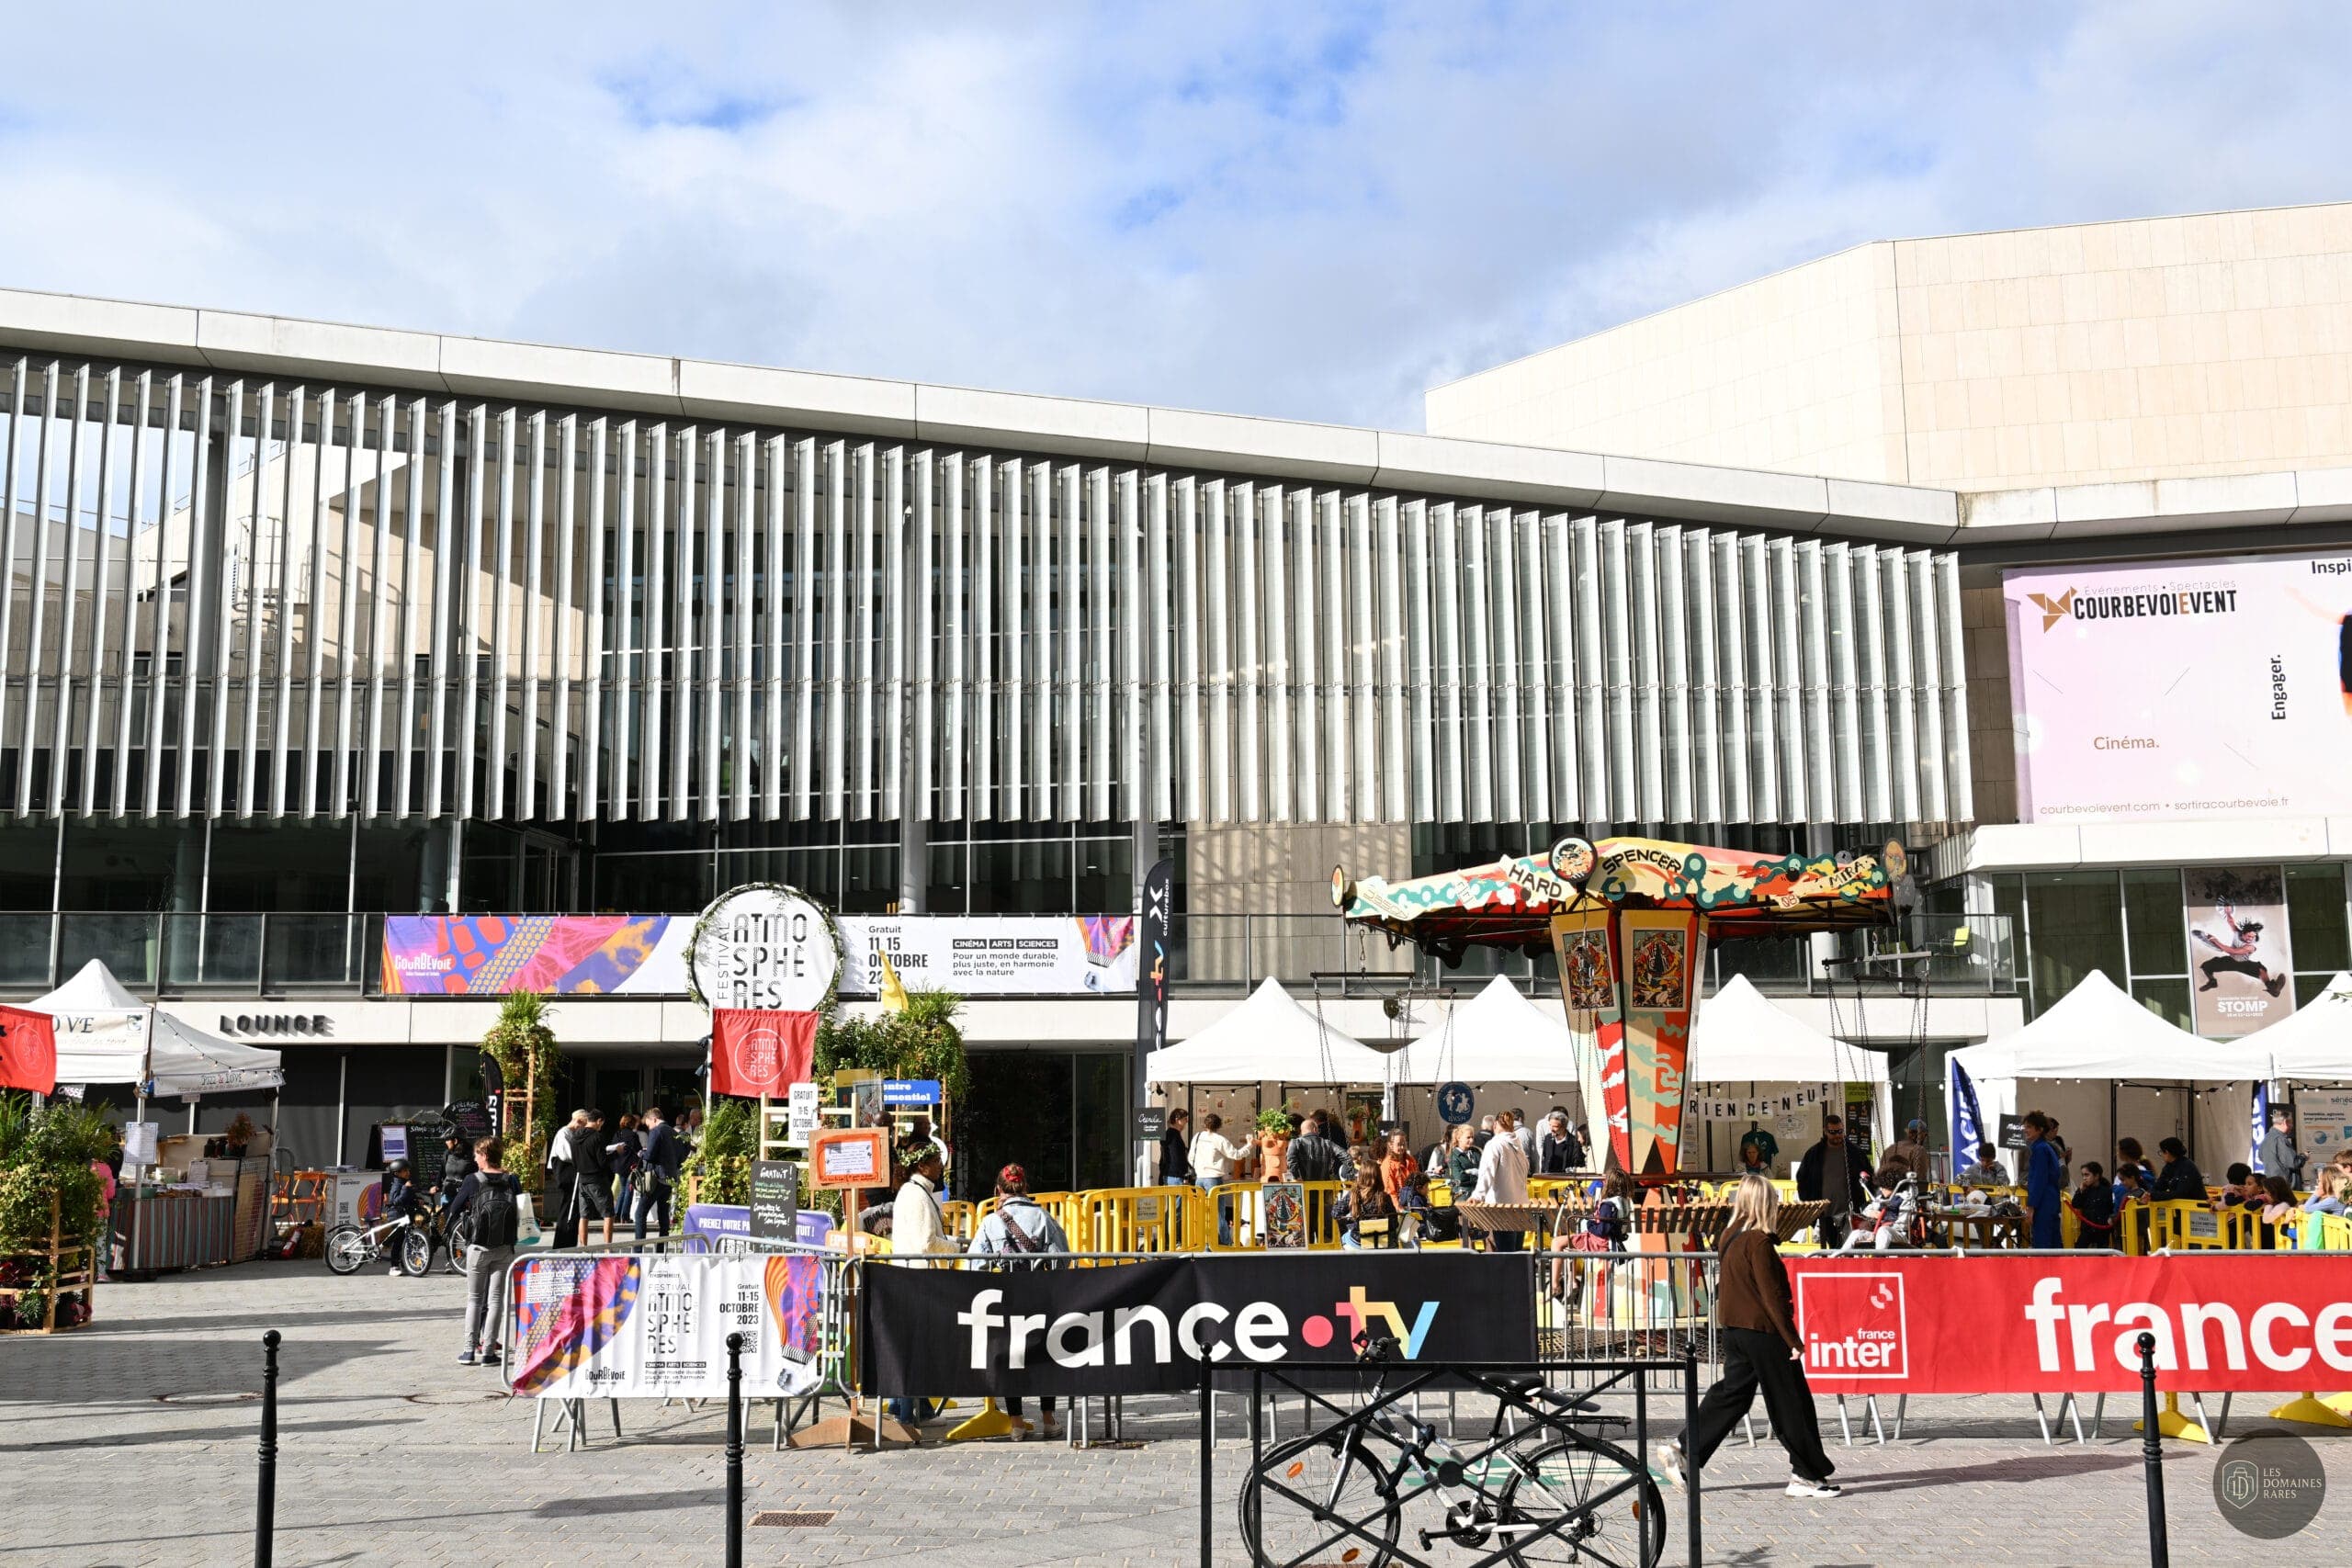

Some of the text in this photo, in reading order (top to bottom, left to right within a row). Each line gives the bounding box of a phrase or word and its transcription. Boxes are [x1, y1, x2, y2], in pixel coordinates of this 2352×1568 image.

[2169, 580, 2236, 592] Spectacles
[2074, 590, 2237, 620] COURBEVOIEVENT
[2271, 655, 2288, 720] Engager.
[2093, 735, 2160, 750] Cinéma.
[2040, 803, 2160, 815] courbevoievent.com
[1602, 849, 1681, 874] SPENCER
[1829, 861, 1865, 887] MIRA
[1509, 863, 1562, 898] HARD
[868, 925, 901, 933] Gratuit
[954, 939, 985, 948] CINÉMA
[718, 922, 729, 999] FESTIVAL
[1023, 952, 1058, 961] durable,
[733, 979, 782, 1010] RES
[2218, 1001, 2268, 1012] STOMP
[220, 1014, 325, 1032] LOUNGE
[750, 1065, 769, 1077] RES
[794, 1091, 813, 1100] GRATUIT
[1690, 1099, 1736, 1117] RIEN
[1781, 1083, 1828, 1111] NEUF
[793, 1118, 813, 1128] OCTOBRE
[797, 1131, 809, 1141] 2023
[699, 1217, 721, 1229] PRENEZ
[722, 1219, 741, 1230] VOTRE
[738, 1292, 759, 1302] 11-15
[719, 1303, 760, 1314] OCTOBRE
[737, 1314, 759, 1325] 2023
[2025, 1277, 2352, 1371] france
[1858, 1328, 1895, 1339] france
[648, 1335, 676, 1354] RES
[1810, 1333, 1896, 1368] inter
